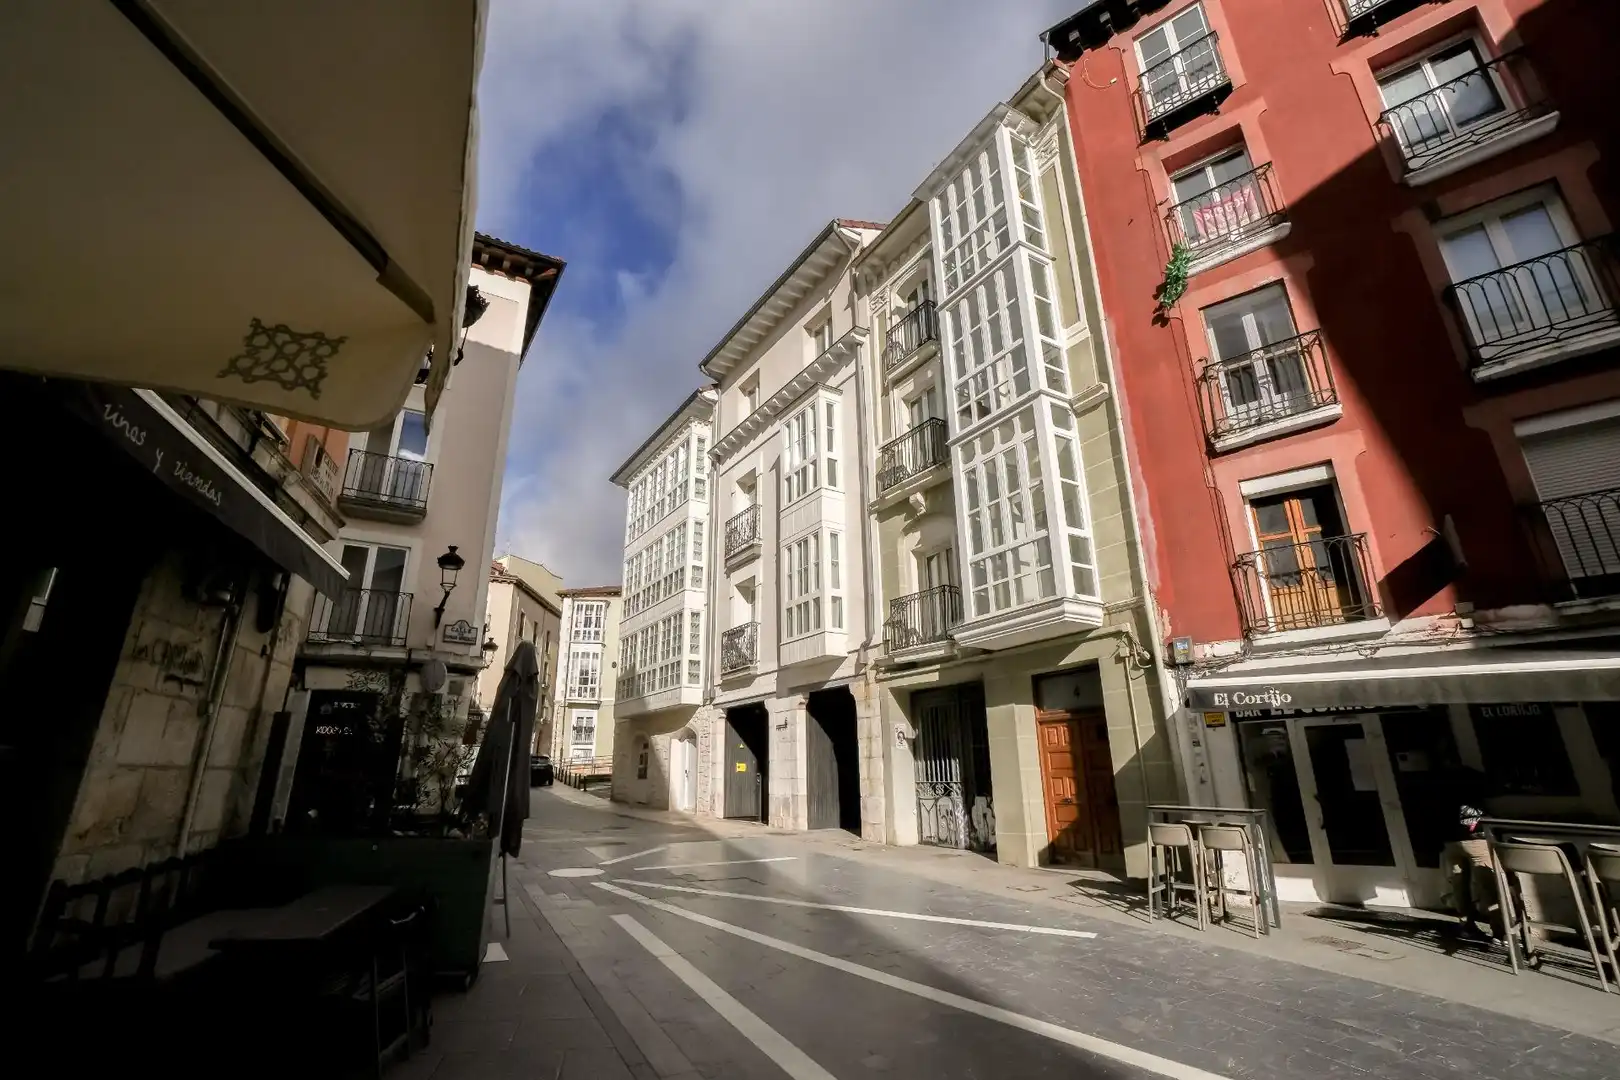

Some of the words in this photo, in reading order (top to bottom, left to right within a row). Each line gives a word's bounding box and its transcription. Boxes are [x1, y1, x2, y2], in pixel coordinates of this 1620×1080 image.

[152, 448, 164, 474] y
[1214, 692, 1230, 709] El
[1233, 686, 1292, 708] Cortijo
